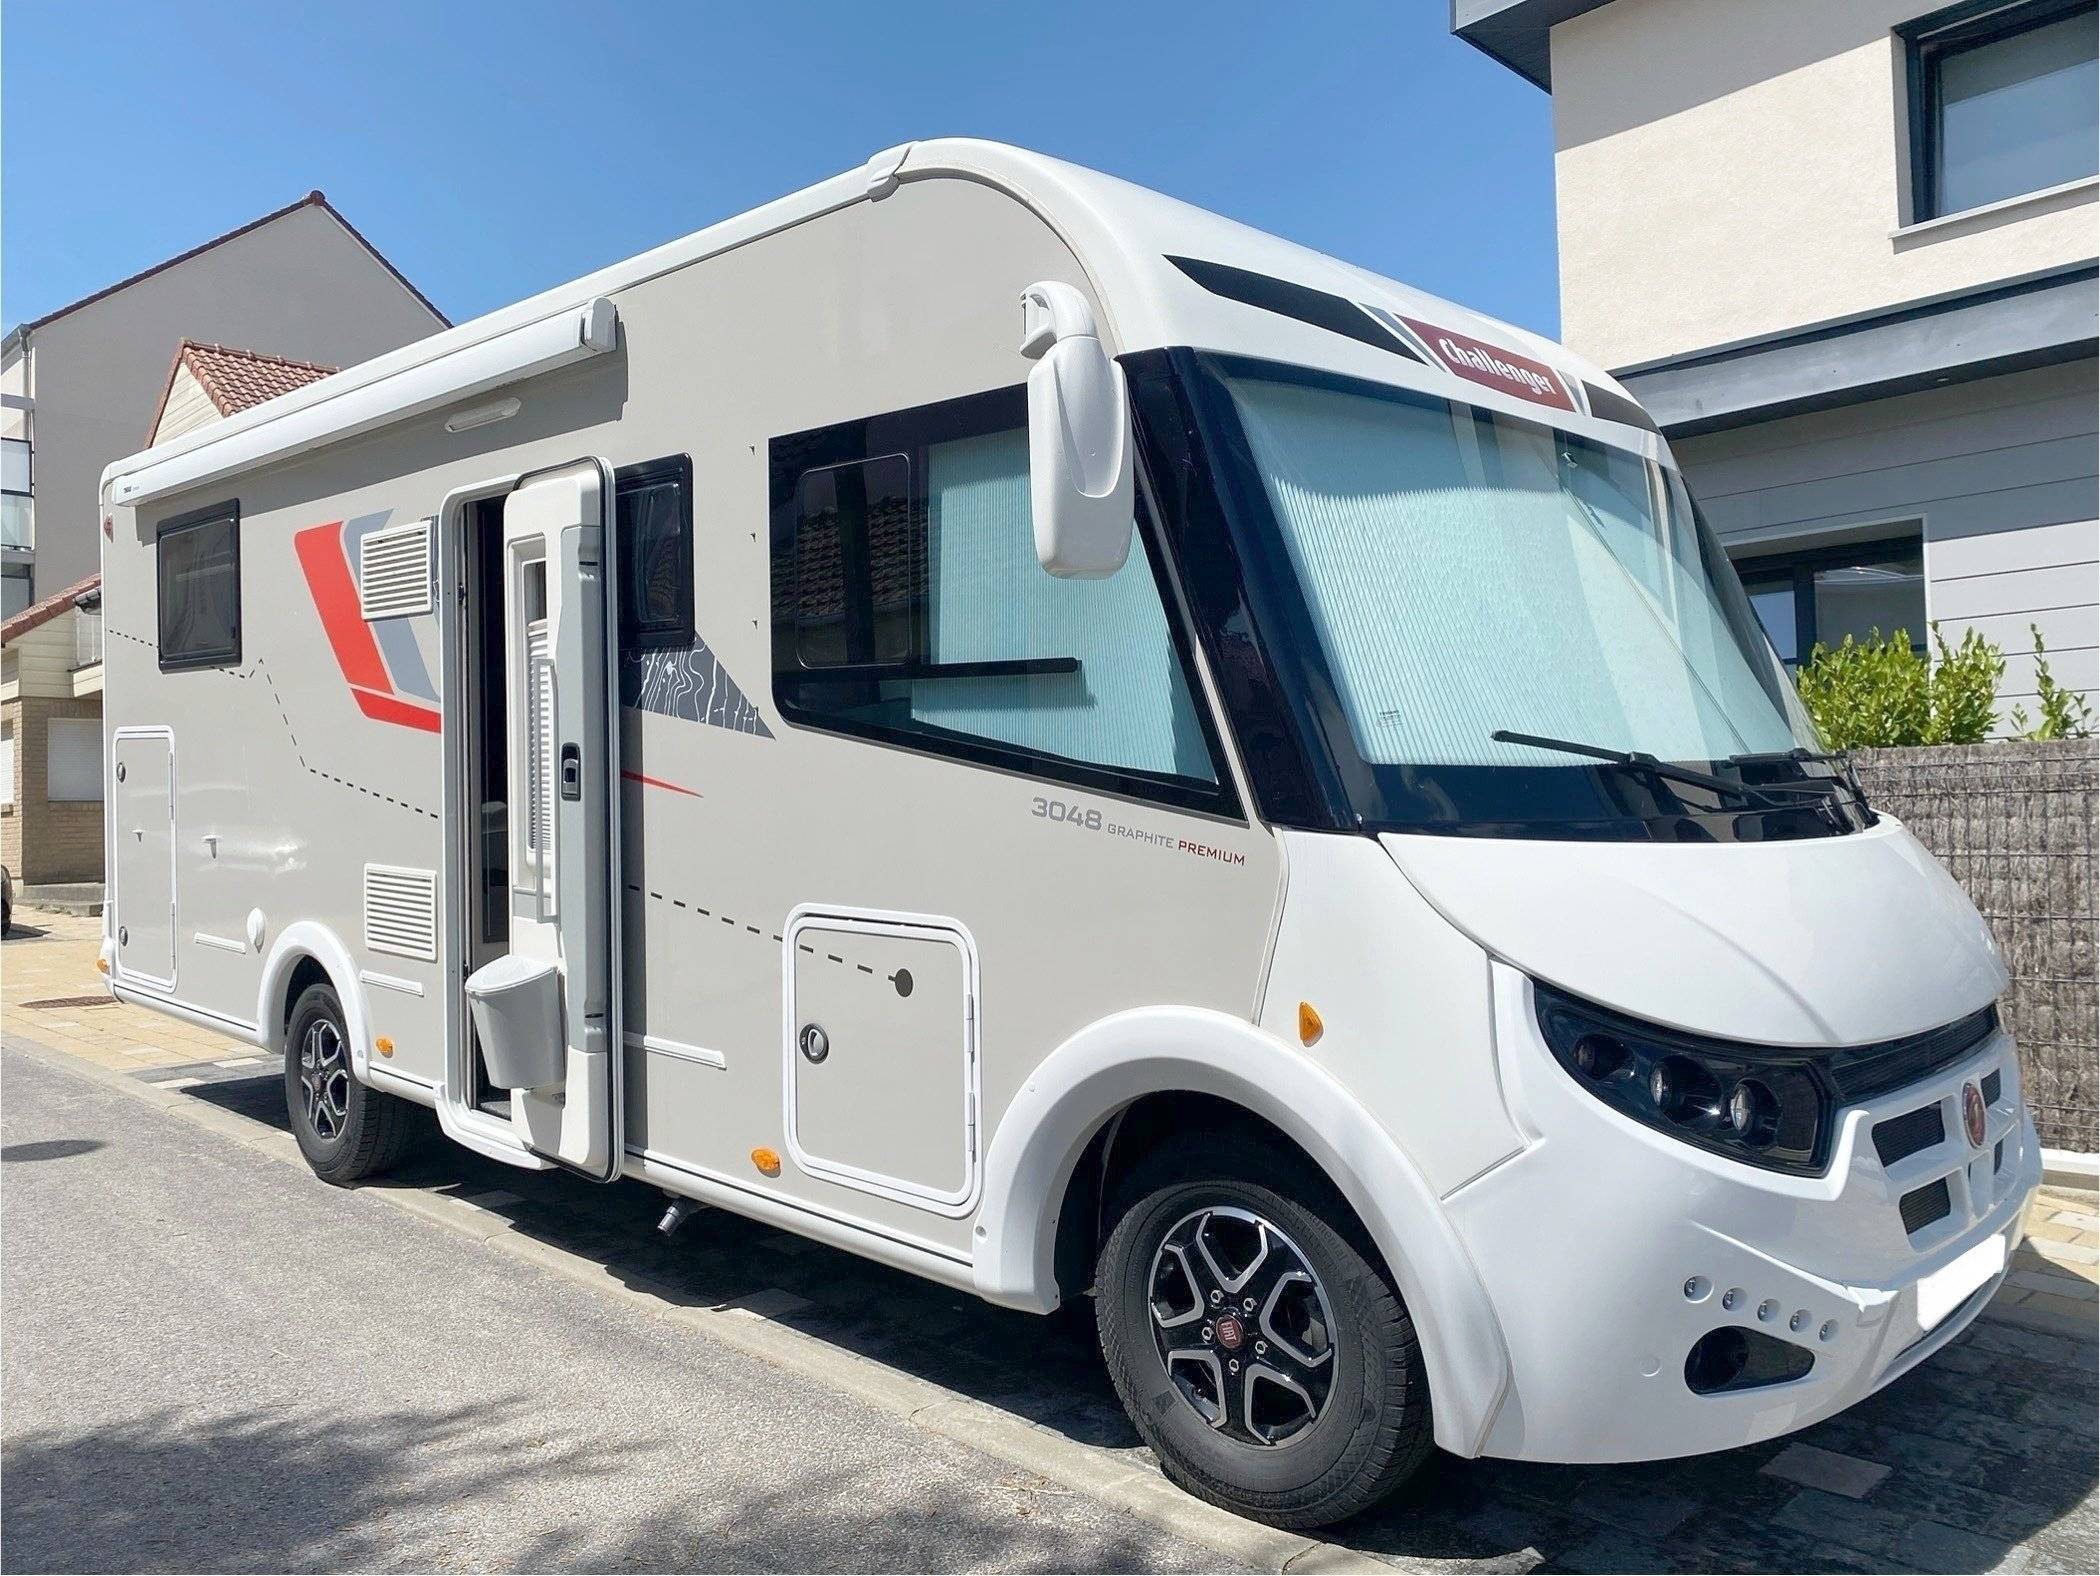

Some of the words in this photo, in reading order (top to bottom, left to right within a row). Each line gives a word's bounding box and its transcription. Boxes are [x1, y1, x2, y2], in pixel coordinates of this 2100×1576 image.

[1439, 338, 1556, 395] Challenger
[1031, 796, 1103, 831] 3048
[1107, 823, 1175, 849] GRAPHITE
[1178, 840, 1245, 866] PREMIUM
[1220, 1320, 1237, 1341] FIAT
